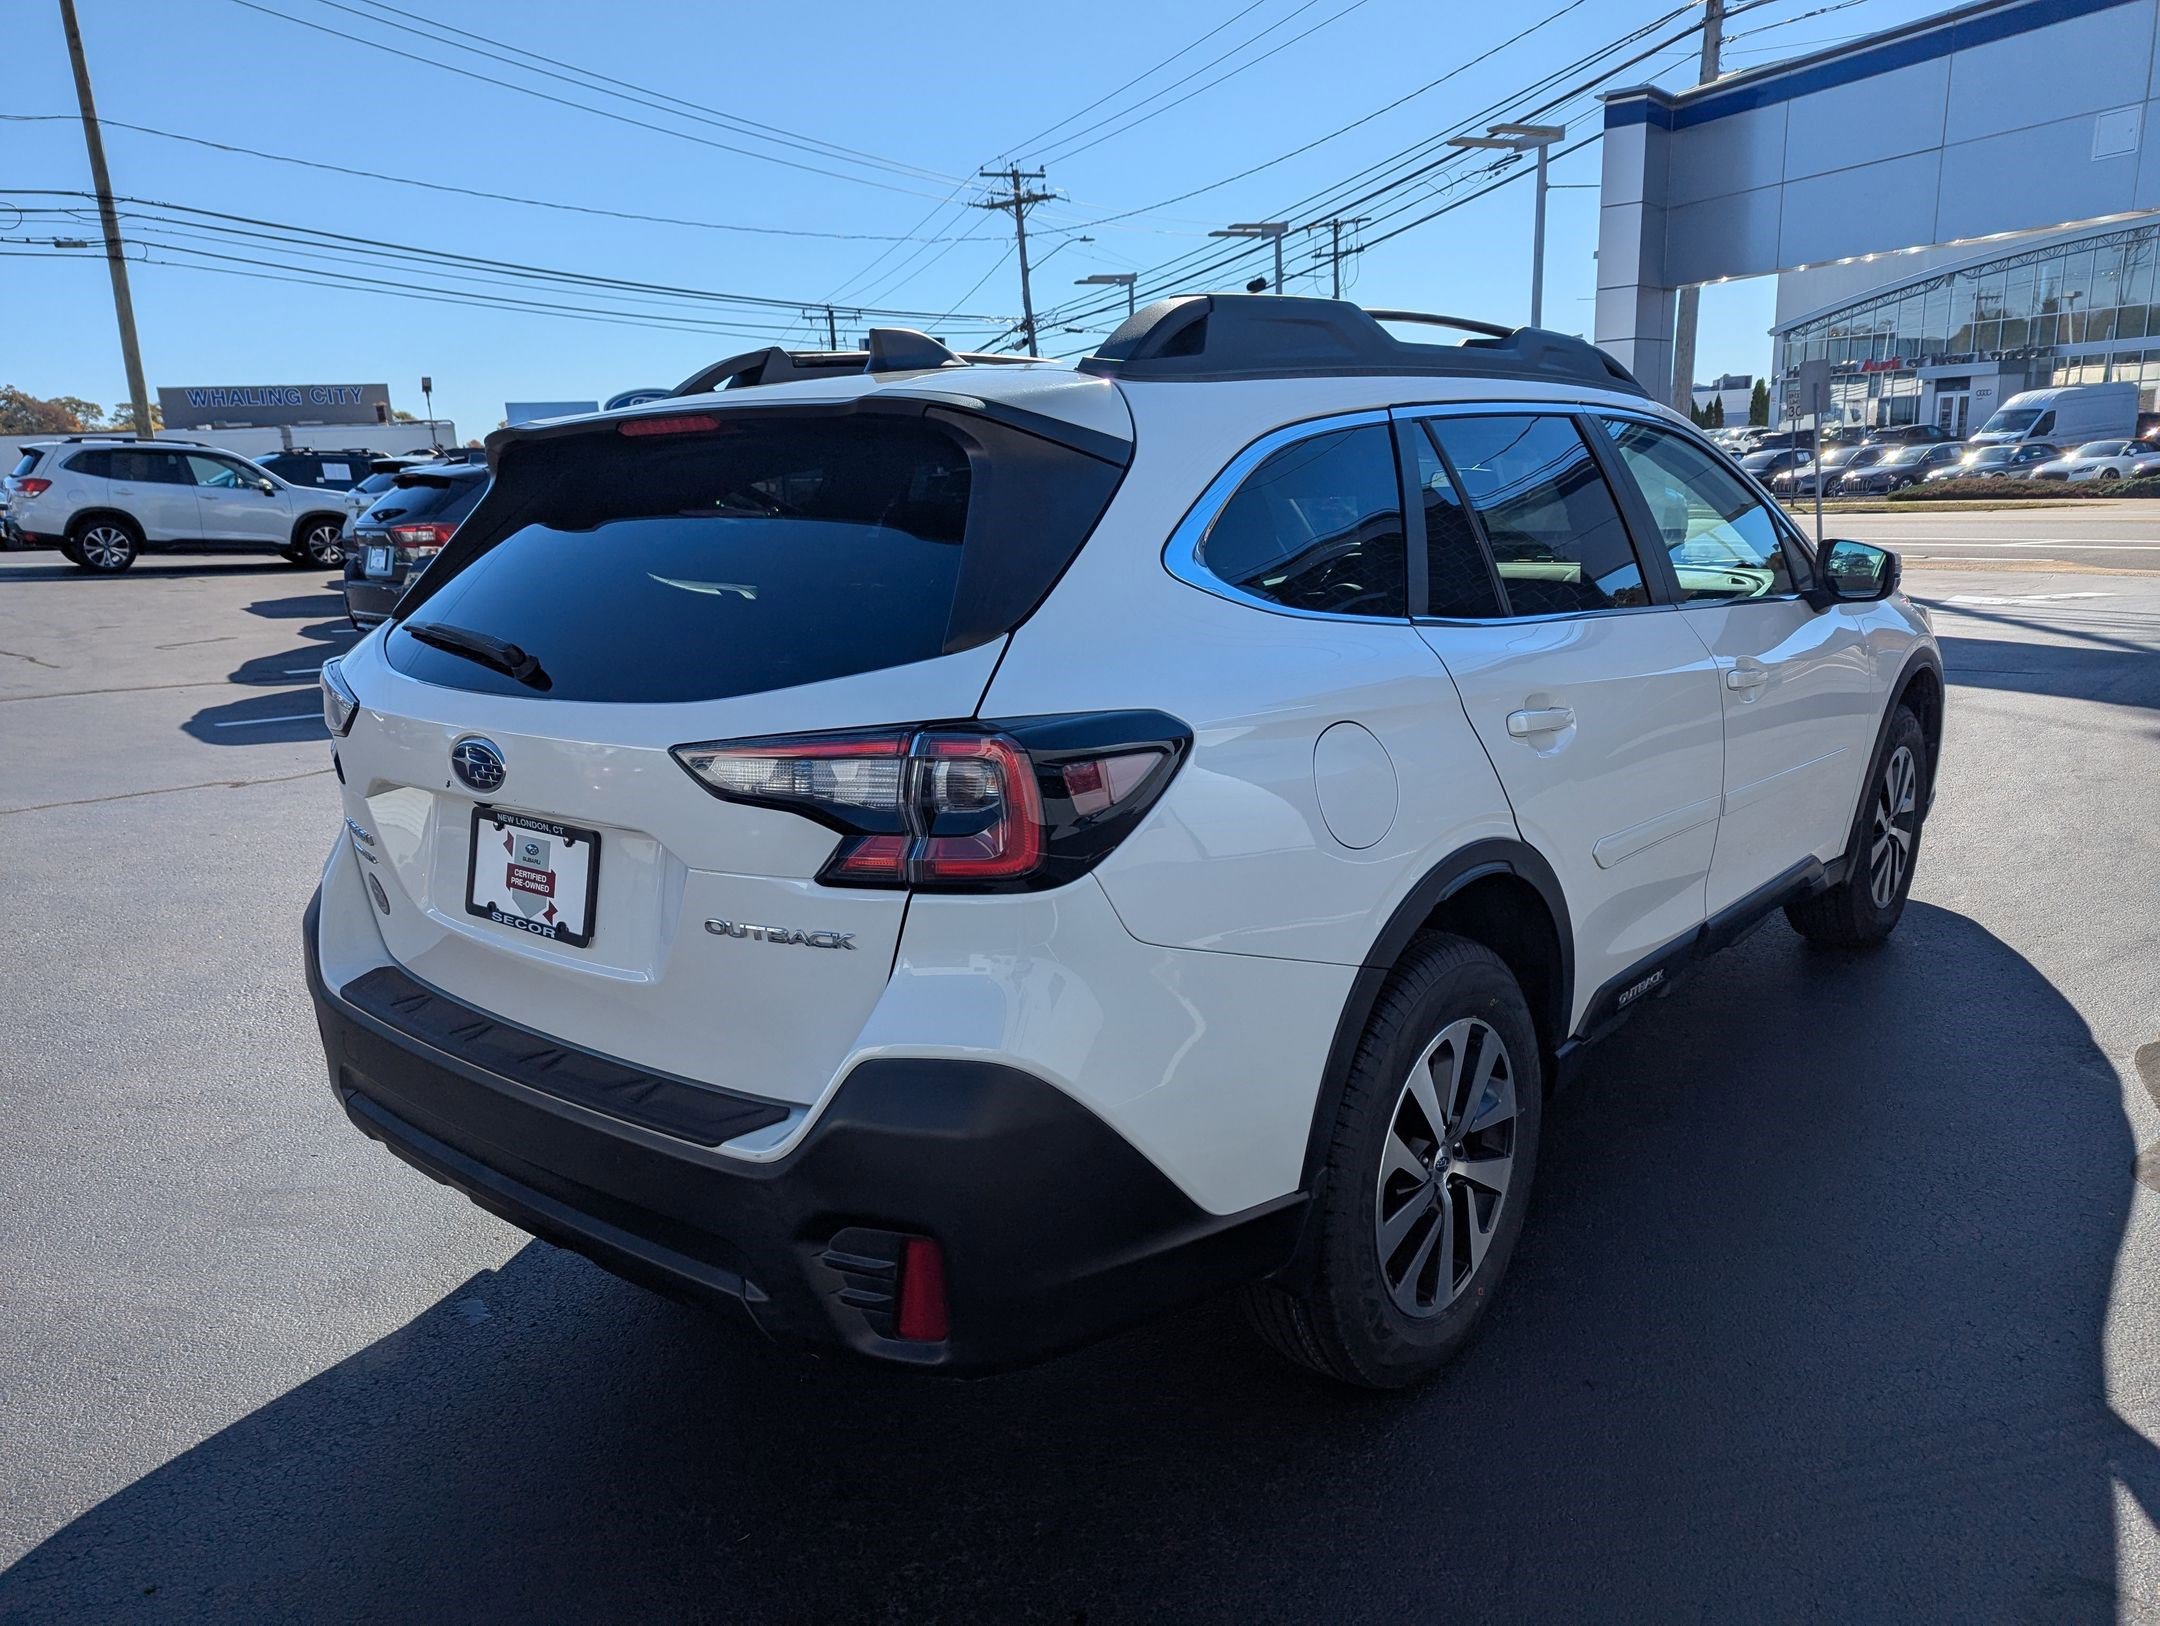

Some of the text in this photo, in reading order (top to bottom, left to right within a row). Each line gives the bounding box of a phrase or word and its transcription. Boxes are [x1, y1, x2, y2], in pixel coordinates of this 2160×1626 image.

[1860, 357, 1901, 372] Audi
[185, 386, 364, 407] WHALING CITY
[497, 813, 514, 824] NEW
[553, 826, 565, 835] CT
[522, 856, 542, 865] SUBARU
[511, 877, 549, 893] PRE-OWNED
[514, 868, 547, 883] CERTIFIED
[491, 911, 556, 938] SECOR
[704, 918, 857, 950] OUTBACK
[1619, 968, 1665, 1003] OUTBACK
